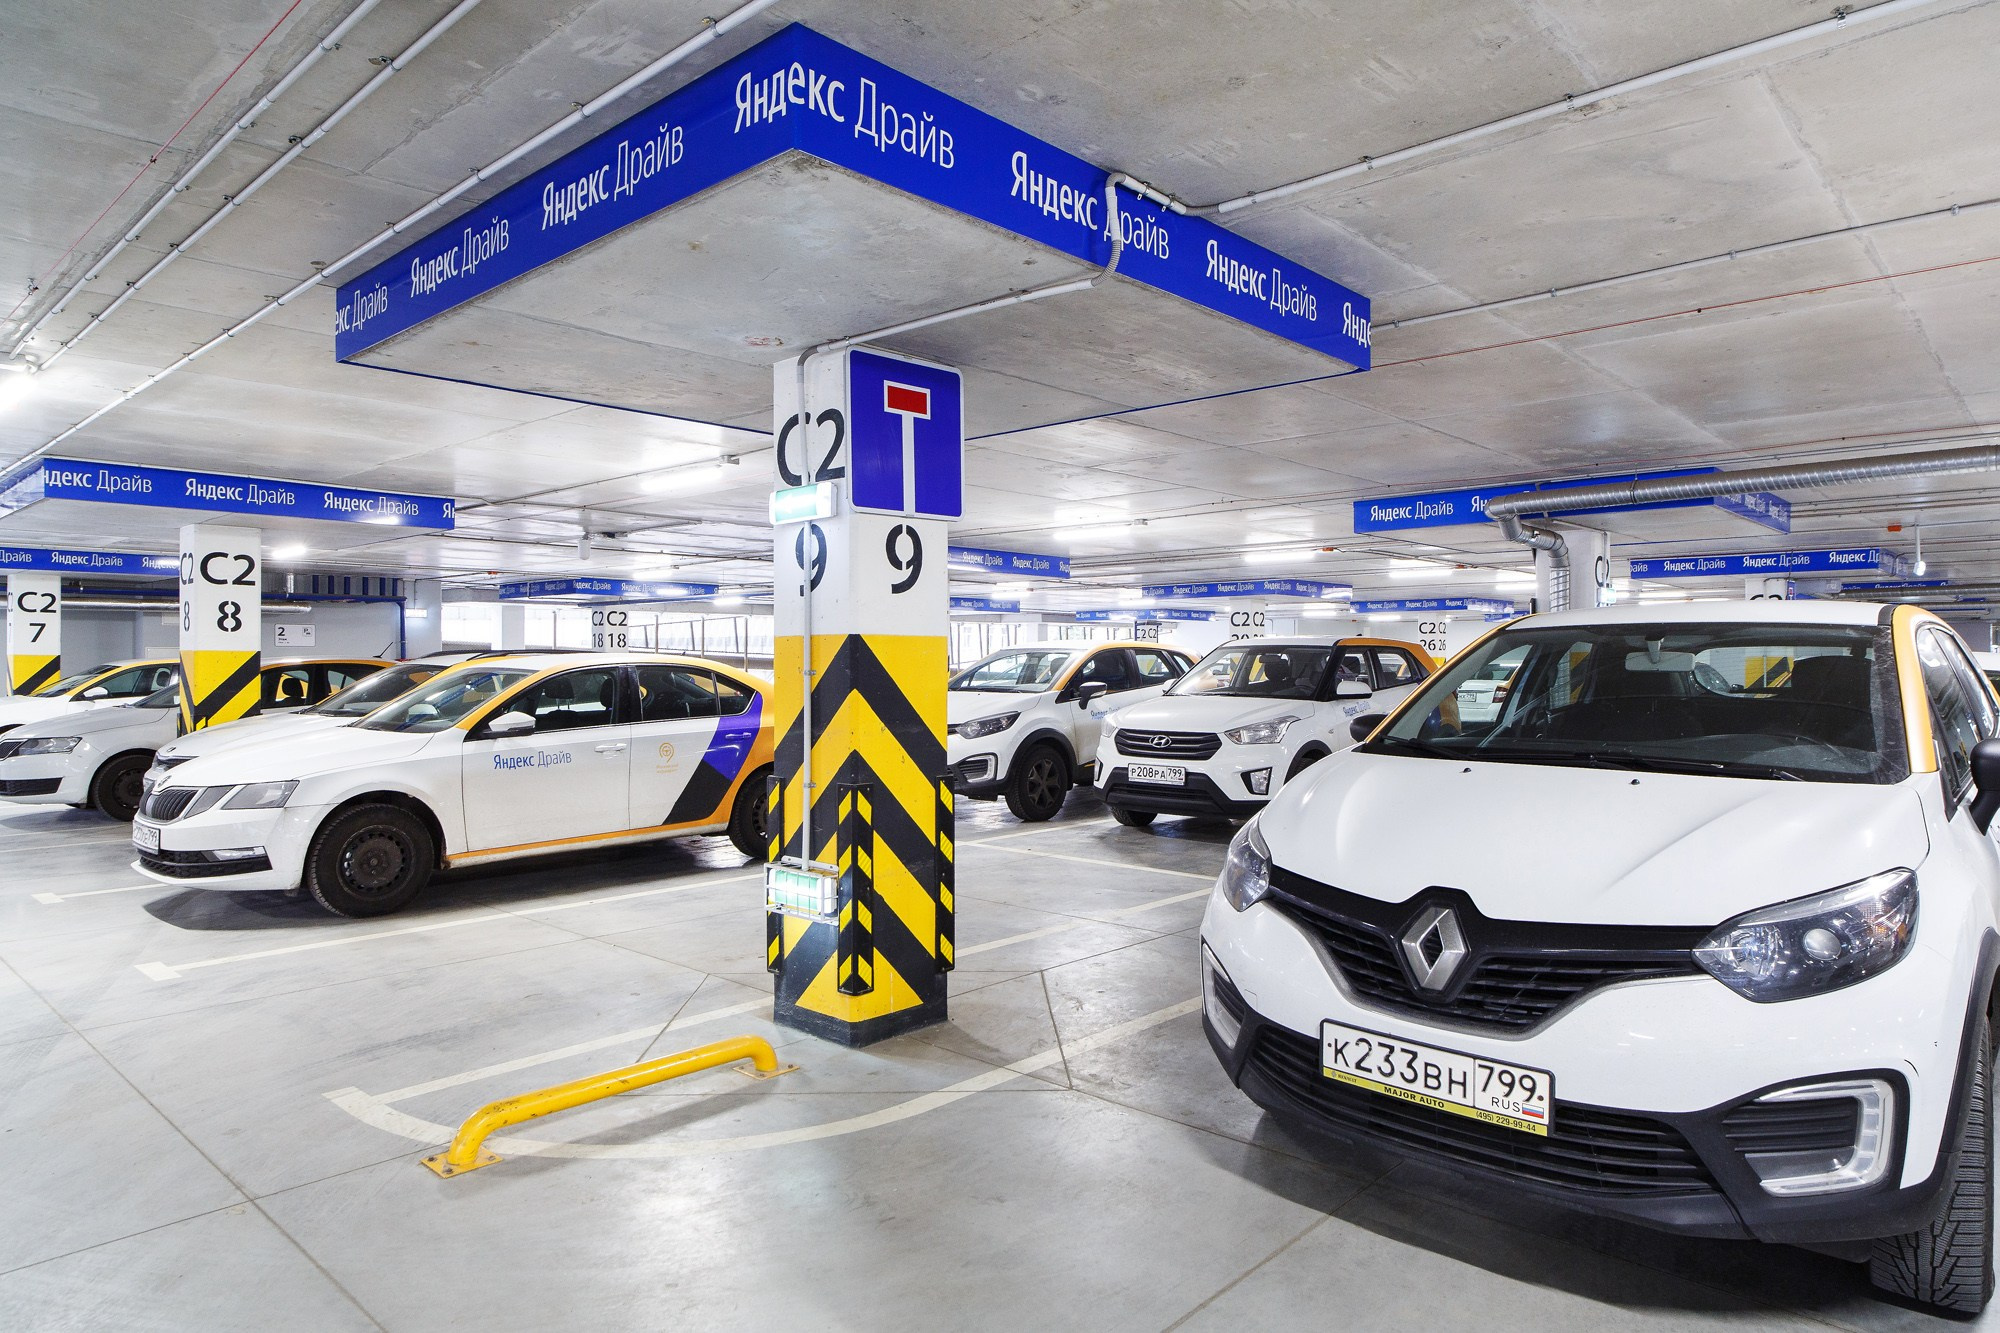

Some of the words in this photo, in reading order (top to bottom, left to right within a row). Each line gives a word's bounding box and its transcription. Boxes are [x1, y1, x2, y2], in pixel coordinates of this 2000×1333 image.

[734, 61, 845, 134] Яндекс
[854, 76, 956, 169] Драйв
[542, 161, 610, 230] Яндекс
[613, 123, 684, 197] Драйв
[1011, 150, 1098, 231] Яндекс
[410, 246, 458, 298] Яндекс
[460, 216, 510, 274] Драйв
[1206, 240, 1268, 302] Яндекс
[1270, 268, 1318, 322] Драйв
[352, 282, 388, 332] Драйв
[96, 469, 152, 493] Драйв
[185, 478, 243, 502] Яндекс
[246, 484, 296, 506] Драйв
[324, 492, 374, 512] Яндекс
[377, 496, 419, 516] Драйв
[1370, 504, 1412, 522] Яндекс
[1414, 501, 1454, 520] Драйв
[51, 552, 88, 565] Яндекс
[90, 553, 123, 566] Драйв
[796, 524, 828, 597] 9
[886, 524, 922, 594] 9
[1664, 560, 1696, 572] Яндекс
[1696, 558, 1726, 571] Драйв
[1742, 556, 1777, 568] Яндекс
[1778, 554, 1811, 567] Драйв
[1828, 552, 1866, 564] Яндекс
[184, 600, 190, 632] 8
[217, 600, 242, 632] 8
[30, 622, 46, 642] 7
[278, 626, 286, 636] 2
[592, 633, 604, 648] 18
[608, 633, 626, 648] 18
[1420, 640, 1436, 650] 26
[1438, 640, 1446, 650] 26
[494, 754, 535, 770] Яндекс
[537, 750, 572, 767] Драйв
[1168, 768, 1182, 778] 799
[1478, 1064, 1536, 1102] 799
[1384, 1086, 1416, 1102] MAJOR
[1420, 1096, 1444, 1108] AUTO
[1491, 1096, 1520, 1112] RUS
[1476, 1110, 1494, 1122] (495)
[1496, 1115, 1536, 1132] 229-99-44
